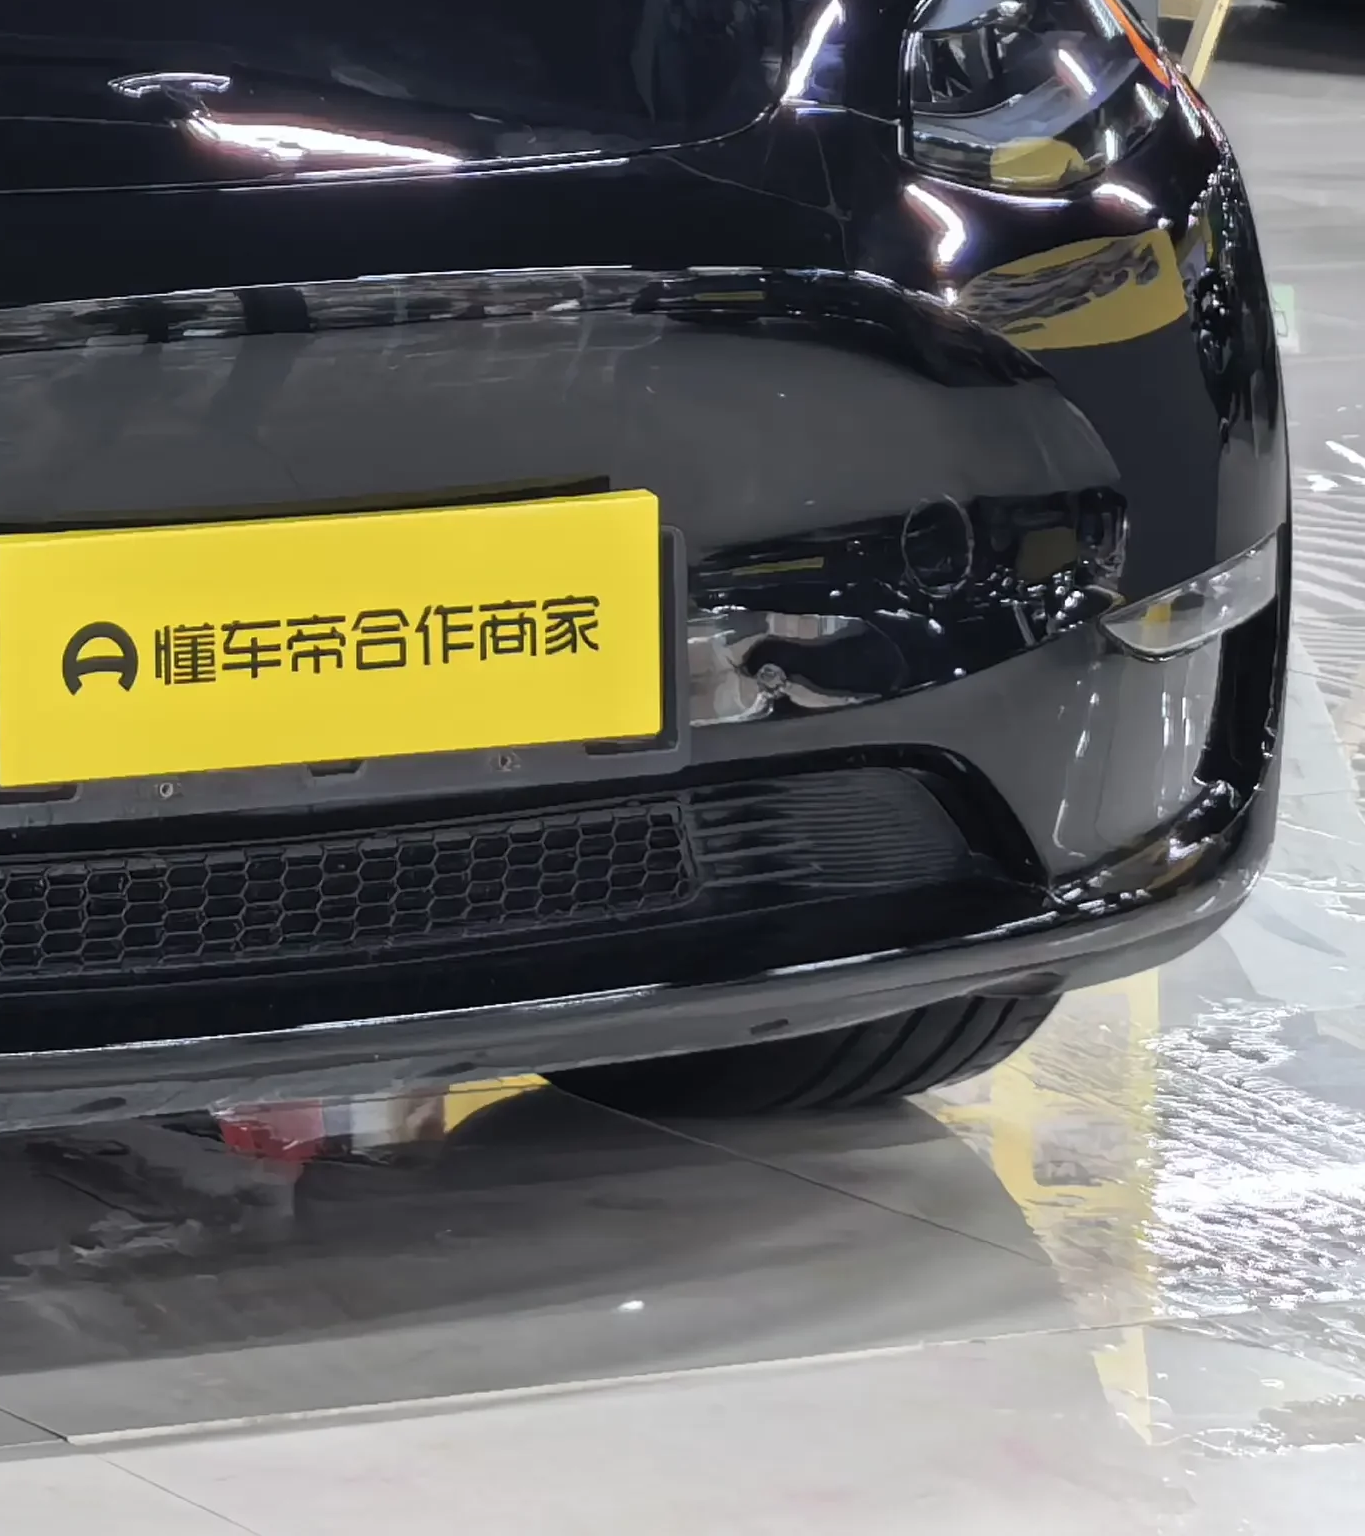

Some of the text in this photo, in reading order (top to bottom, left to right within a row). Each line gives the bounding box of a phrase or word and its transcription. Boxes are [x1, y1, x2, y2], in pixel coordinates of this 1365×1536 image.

[154, 595, 600, 686] 懂车帝合作商家
